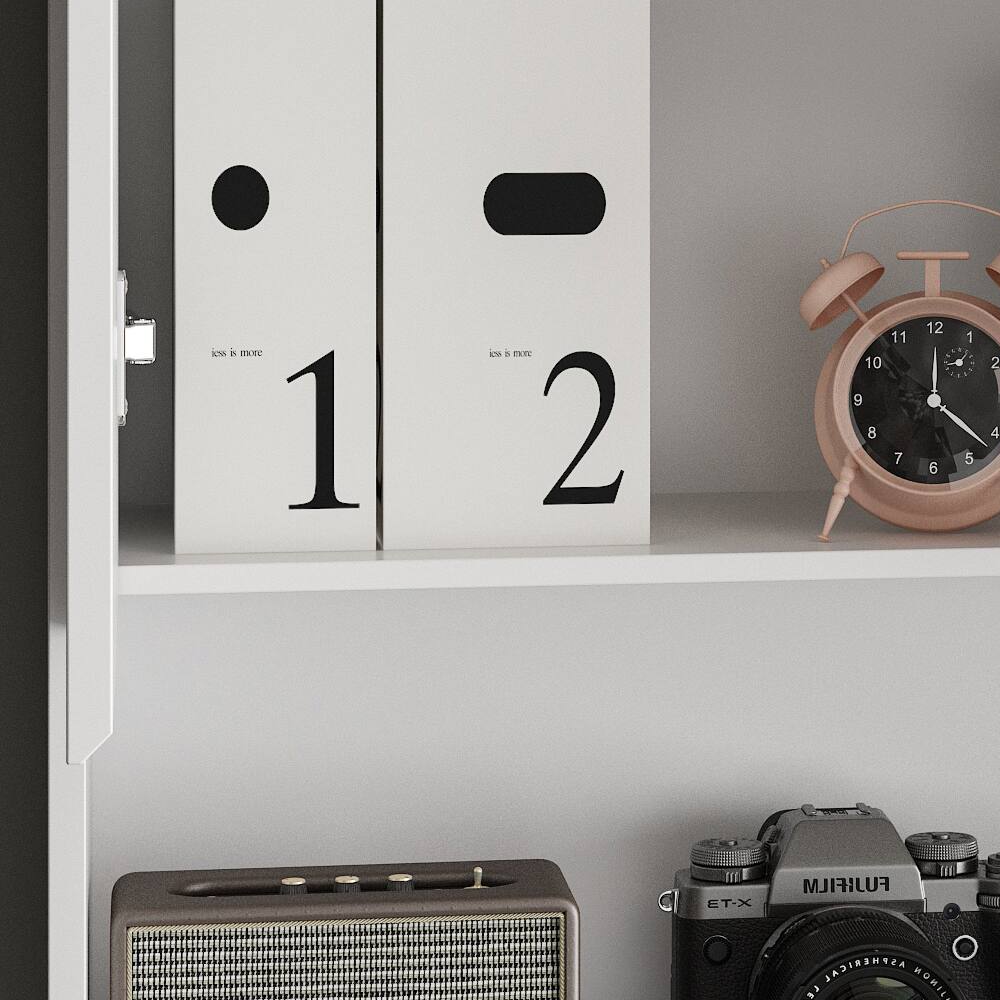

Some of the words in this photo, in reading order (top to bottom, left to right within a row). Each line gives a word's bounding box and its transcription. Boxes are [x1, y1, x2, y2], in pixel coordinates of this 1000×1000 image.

[927, 321, 944, 334] 12
[891, 331, 906, 343] 11
[966, 331, 973, 343] 1
[230, 347, 237, 357] is
[240, 349, 263, 358] more
[504, 347, 511, 358] is
[513, 350, 533, 358] more
[865, 356, 882, 369] 10
[991, 356, 1000, 369] 2
[853, 394, 863, 407] 9
[286, 349, 360, 510] 1
[542, 350, 625, 506] 2
[867, 426, 877, 439] 8
[990, 426, 1000, 439] 4
[894, 452, 903, 464] 7
[964, 453, 974, 465] 5
[929, 461, 938, 475] 6
